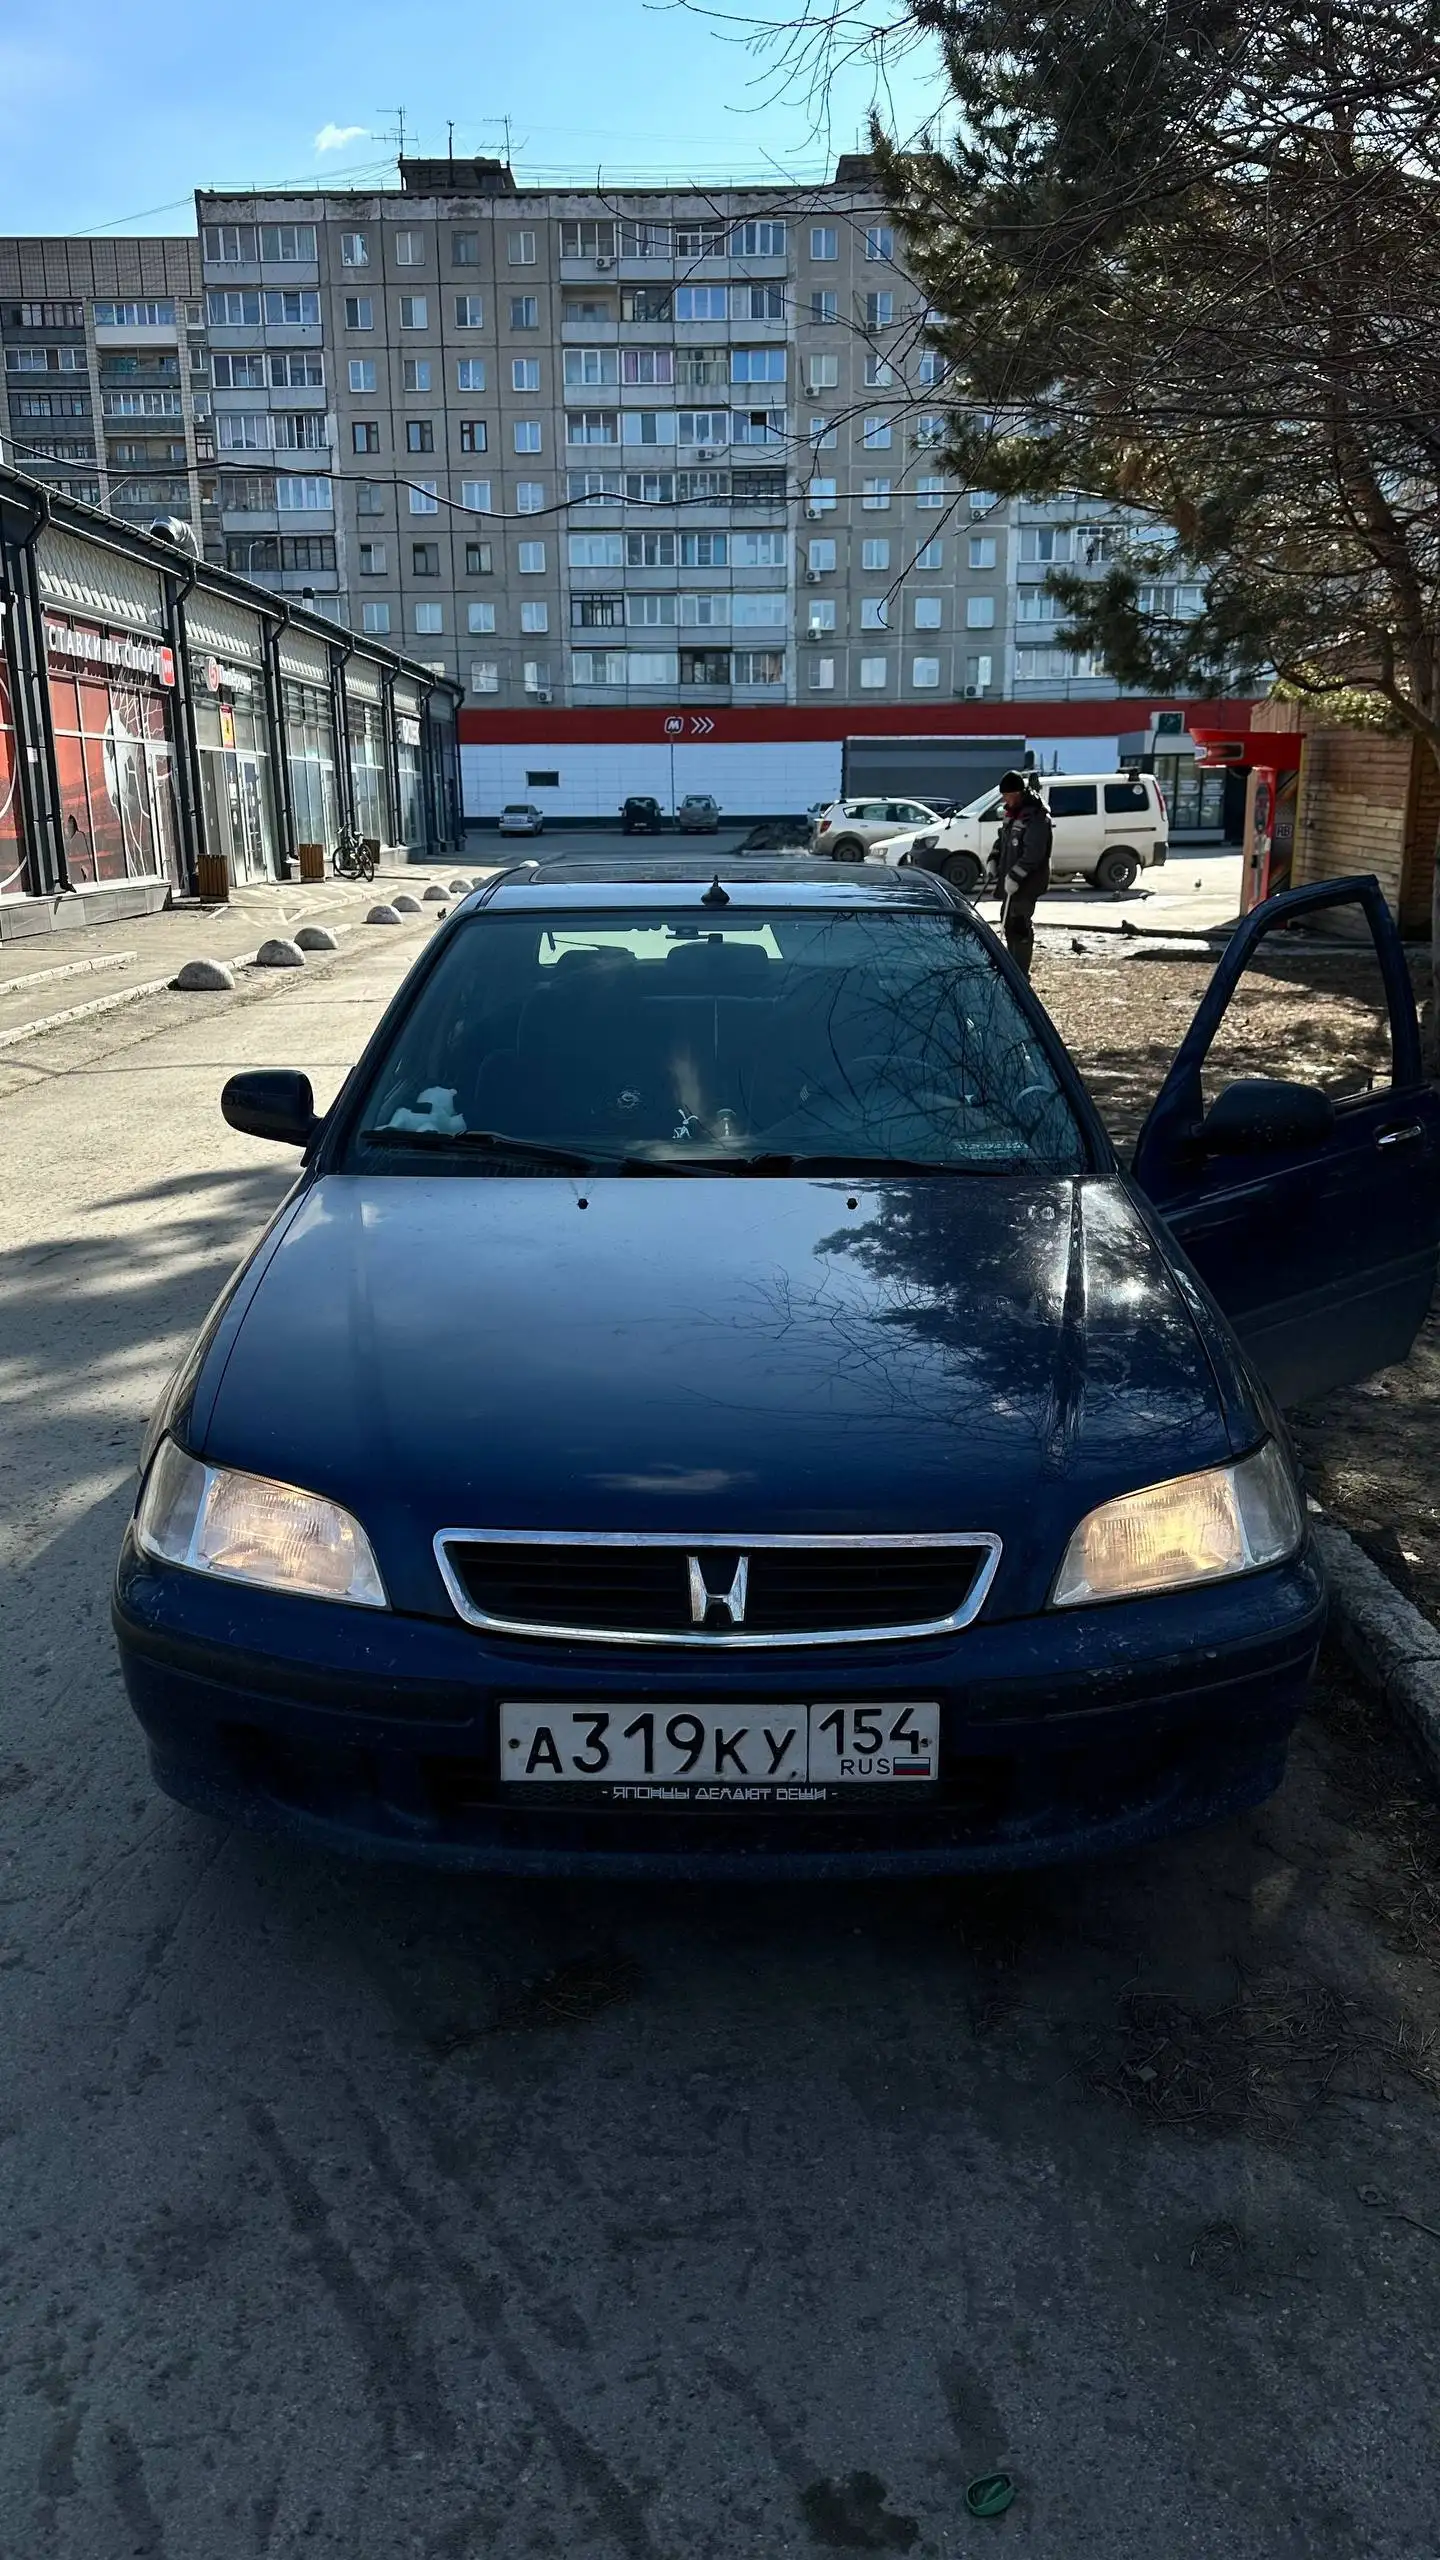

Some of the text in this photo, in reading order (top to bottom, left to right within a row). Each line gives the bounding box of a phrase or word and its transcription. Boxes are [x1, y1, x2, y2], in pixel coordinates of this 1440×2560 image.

[48, 624, 101, 661] СТАВКИ
[105, 639, 121, 666] НА
[124, 644, 160, 674] СПОРТ
[525, 1708, 919, 1774] А319КУ 154
[841, 1758, 890, 1776] RUS
[612, 1787, 827, 1801] ЯПОНЦЫ ДЕЛАЮТ ВЕЩИ
